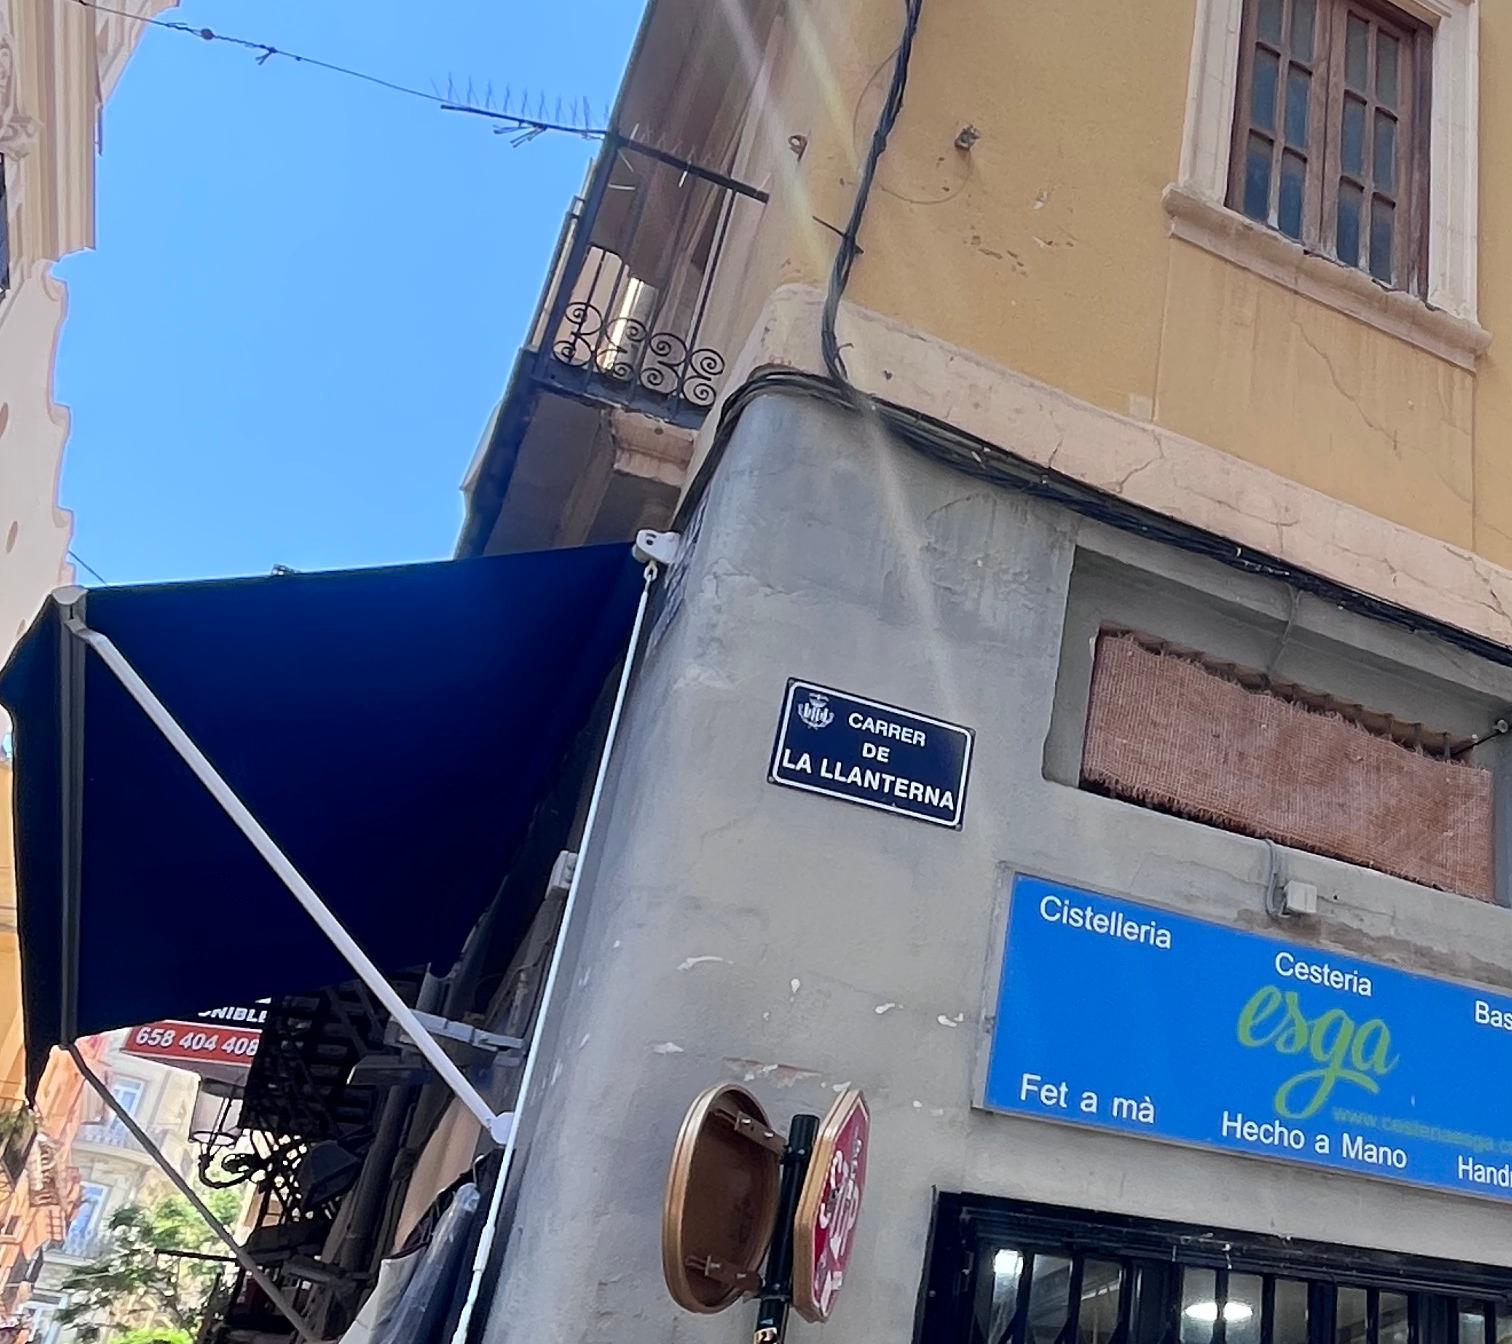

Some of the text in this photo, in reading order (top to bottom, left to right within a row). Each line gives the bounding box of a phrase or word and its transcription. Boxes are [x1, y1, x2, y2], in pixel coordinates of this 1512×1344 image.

[848, 713, 926, 747] CARRER
[862, 742, 890, 763] DE
[782, 748, 954, 810] LA LLANTERNA
[1039, 896, 1173, 950] Cistelleria
[1274, 951, 1373, 997] Cesteria
[135, 1026, 259, 1056] 658 404 408
[1236, 984, 1400, 1120] esga
[1020, 1073, 1157, 1124] Fet a mà
[1221, 1110, 1408, 1169] Hecho a Mano
